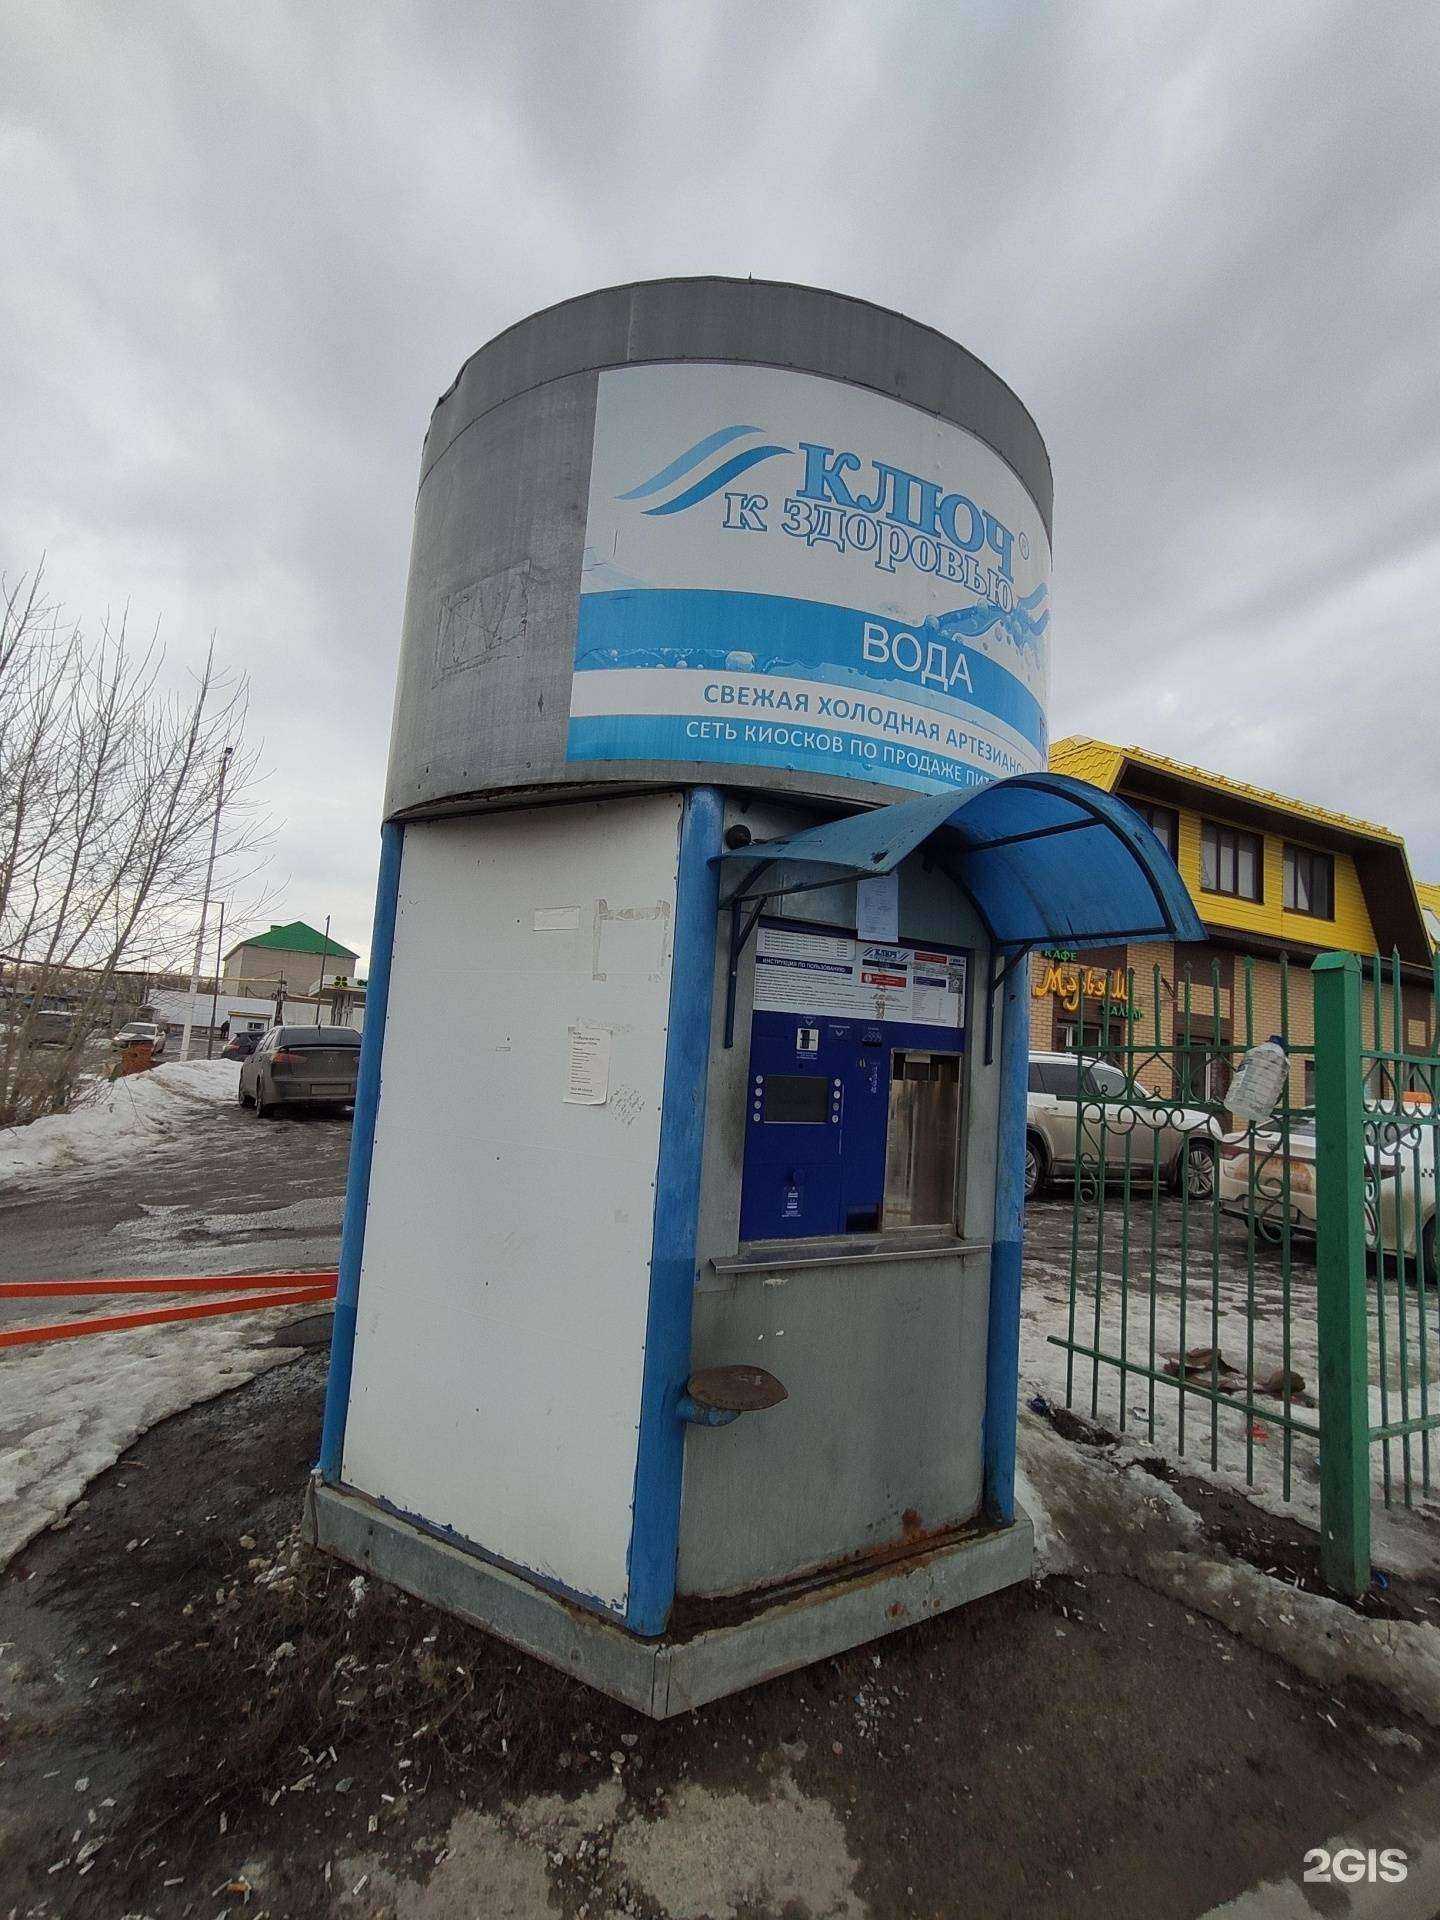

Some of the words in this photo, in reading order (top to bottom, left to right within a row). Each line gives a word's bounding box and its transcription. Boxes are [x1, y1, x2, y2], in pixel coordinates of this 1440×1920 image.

[796, 442, 1015, 584] КЛЮЧ
[862, 621, 973, 694] ВОДА
[703, 684, 809, 713] СВЕЖАЯ
[817, 696, 941, 742] ХОЛОДНАЯ
[686, 721, 738, 741] СЕТЬ
[744, 725, 844, 754] КИОСКОВ
[850, 739, 878, 760] ПО
[883, 745, 962, 783] ПРОДАЖЕ
